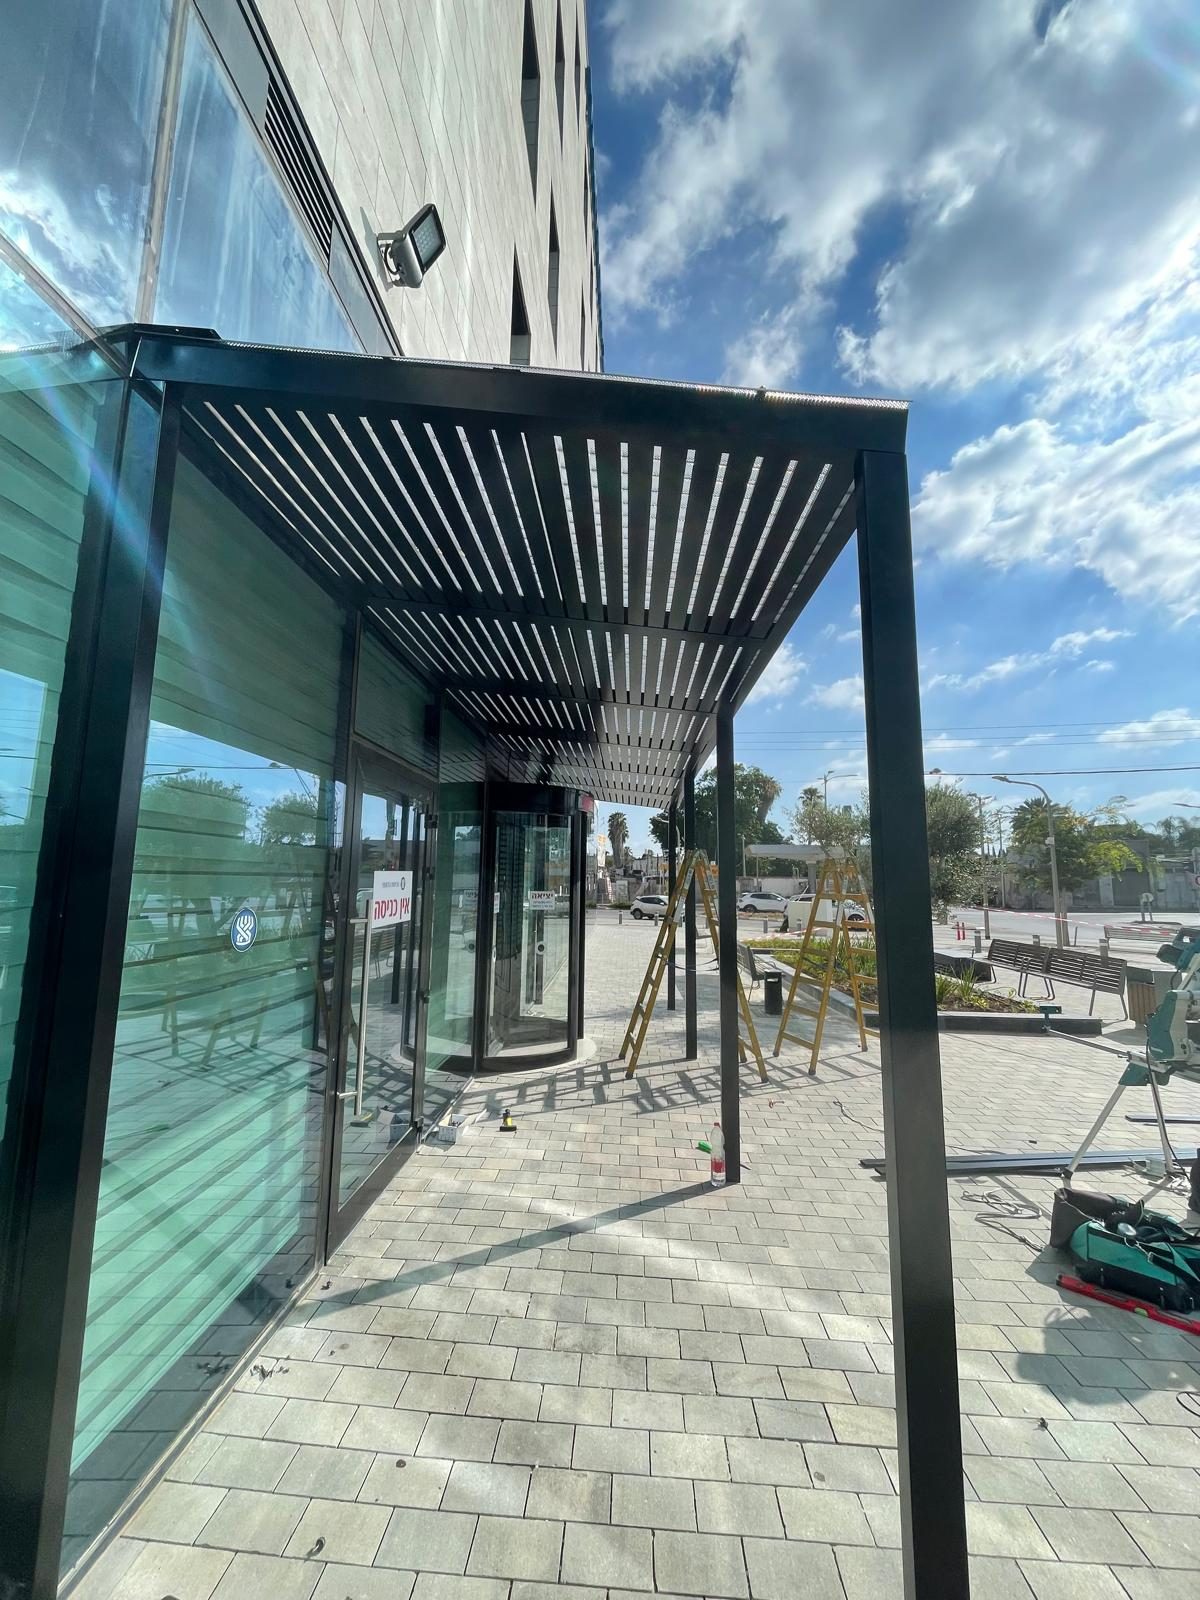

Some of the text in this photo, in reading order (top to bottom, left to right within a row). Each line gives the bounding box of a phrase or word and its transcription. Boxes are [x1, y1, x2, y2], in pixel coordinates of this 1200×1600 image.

[531, 892, 554, 900] יציאה
[374, 897, 410, 920] אין כניסה
